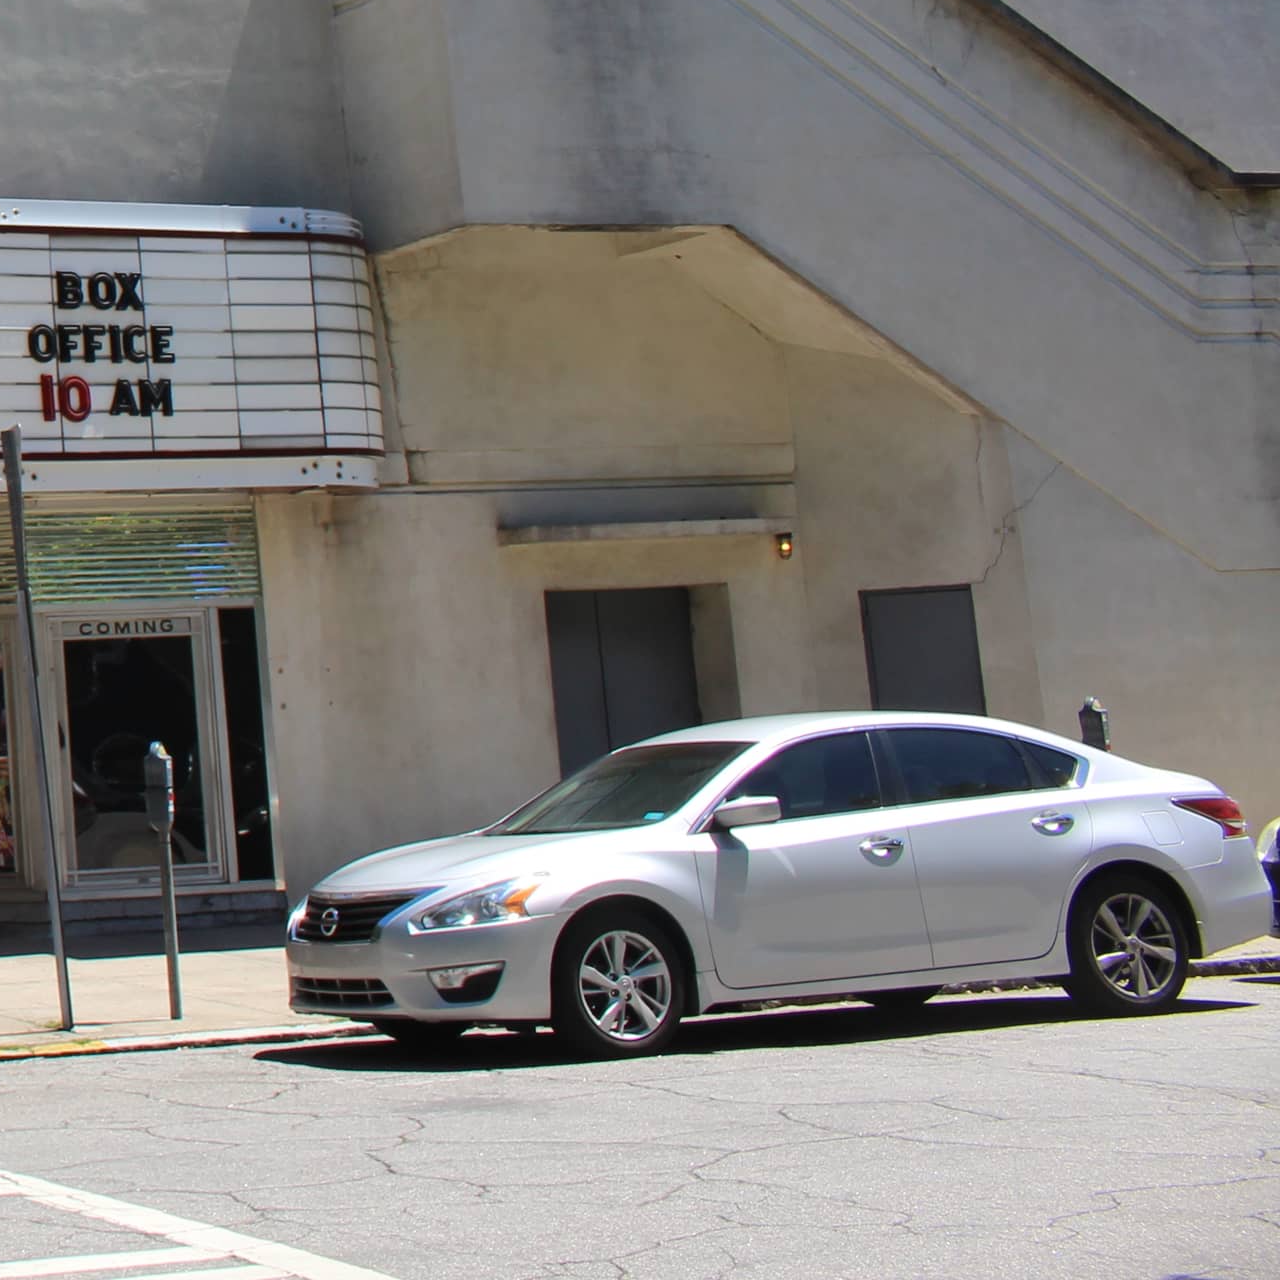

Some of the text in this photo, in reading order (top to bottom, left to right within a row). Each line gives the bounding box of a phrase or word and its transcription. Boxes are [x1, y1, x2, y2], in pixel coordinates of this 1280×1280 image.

[55, 270, 144, 311] BOX
[28, 324, 175, 363] OFFICE
[40, 373, 174, 422] 10 AM
[79, 619, 174, 636] COMING
